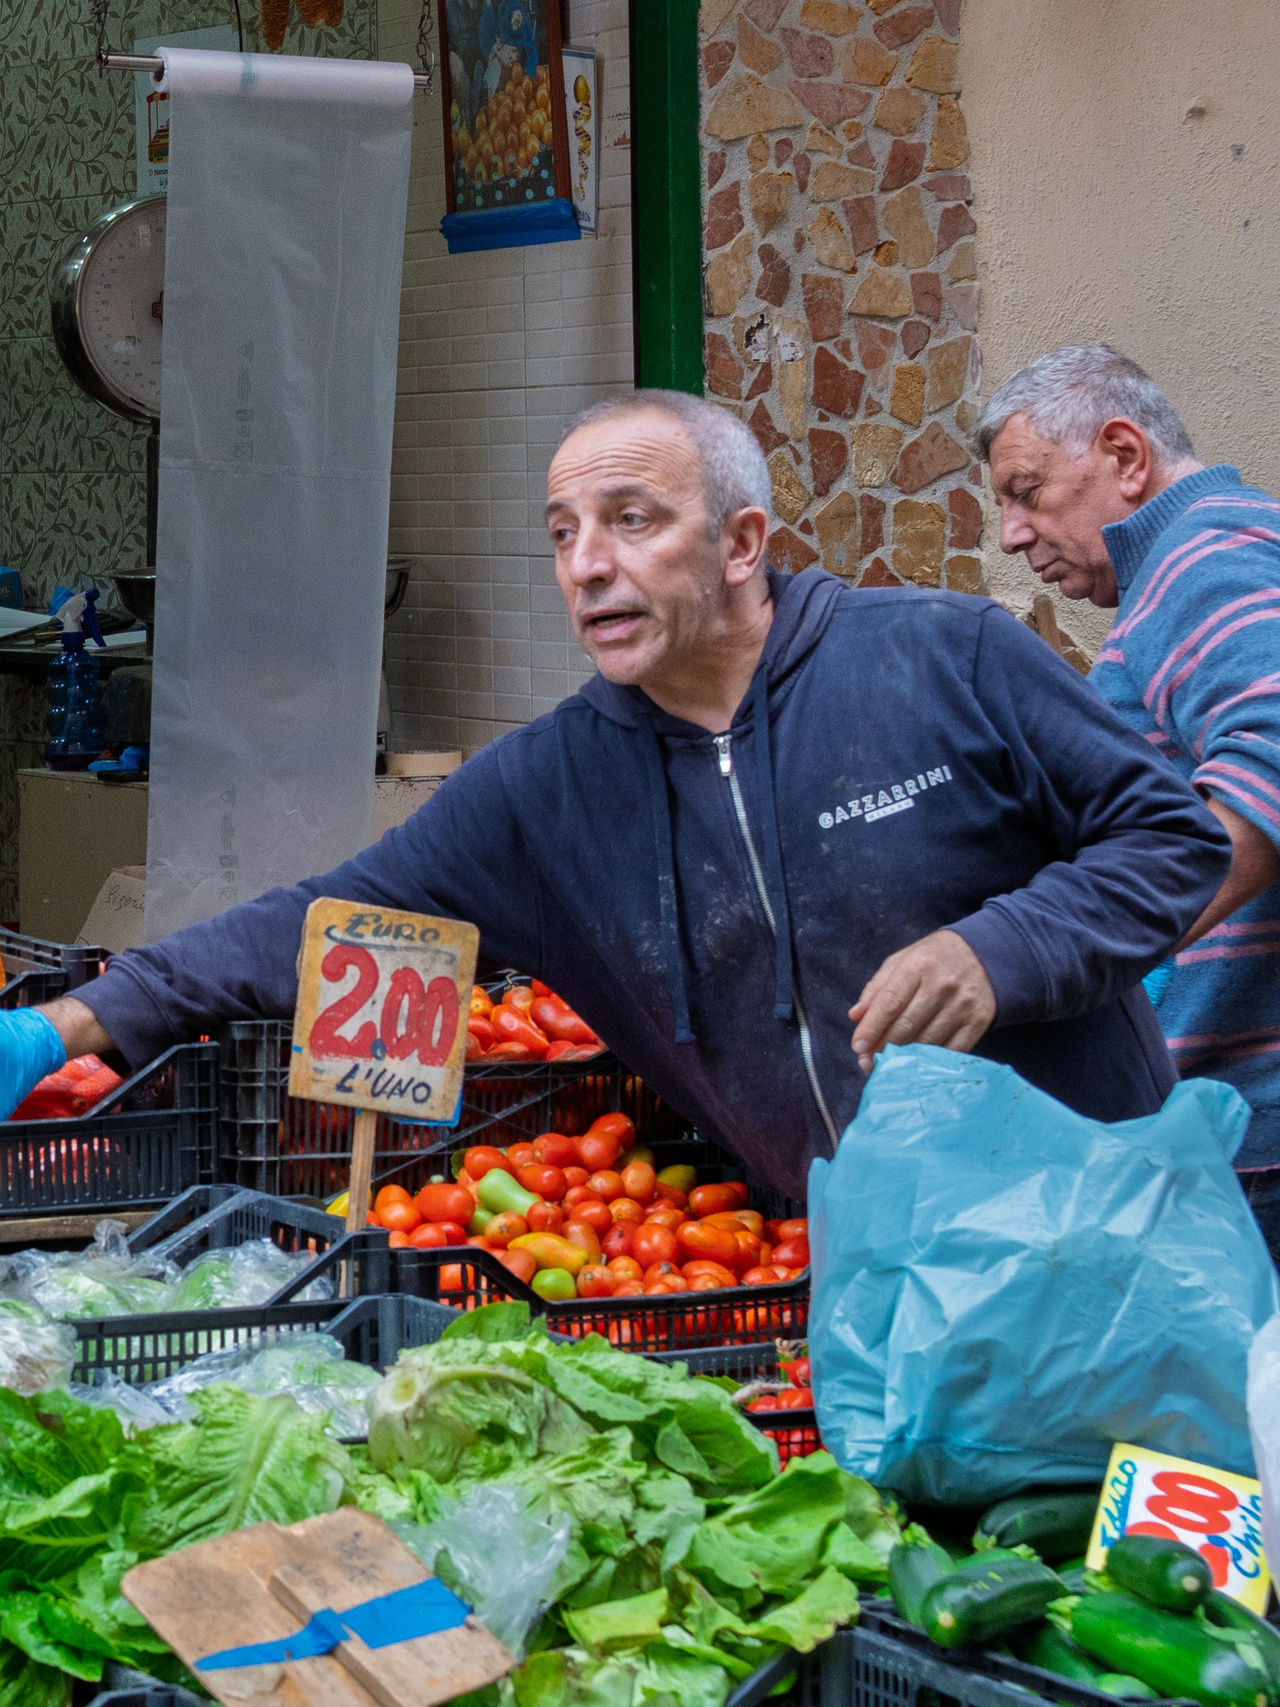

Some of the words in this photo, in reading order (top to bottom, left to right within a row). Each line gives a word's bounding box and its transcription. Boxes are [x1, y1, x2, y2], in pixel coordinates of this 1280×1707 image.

[0, 586, 11, 595] XL
[818, 765, 954, 829] GAZZARRINI
[334, 1063, 432, 1104] L'UNO
